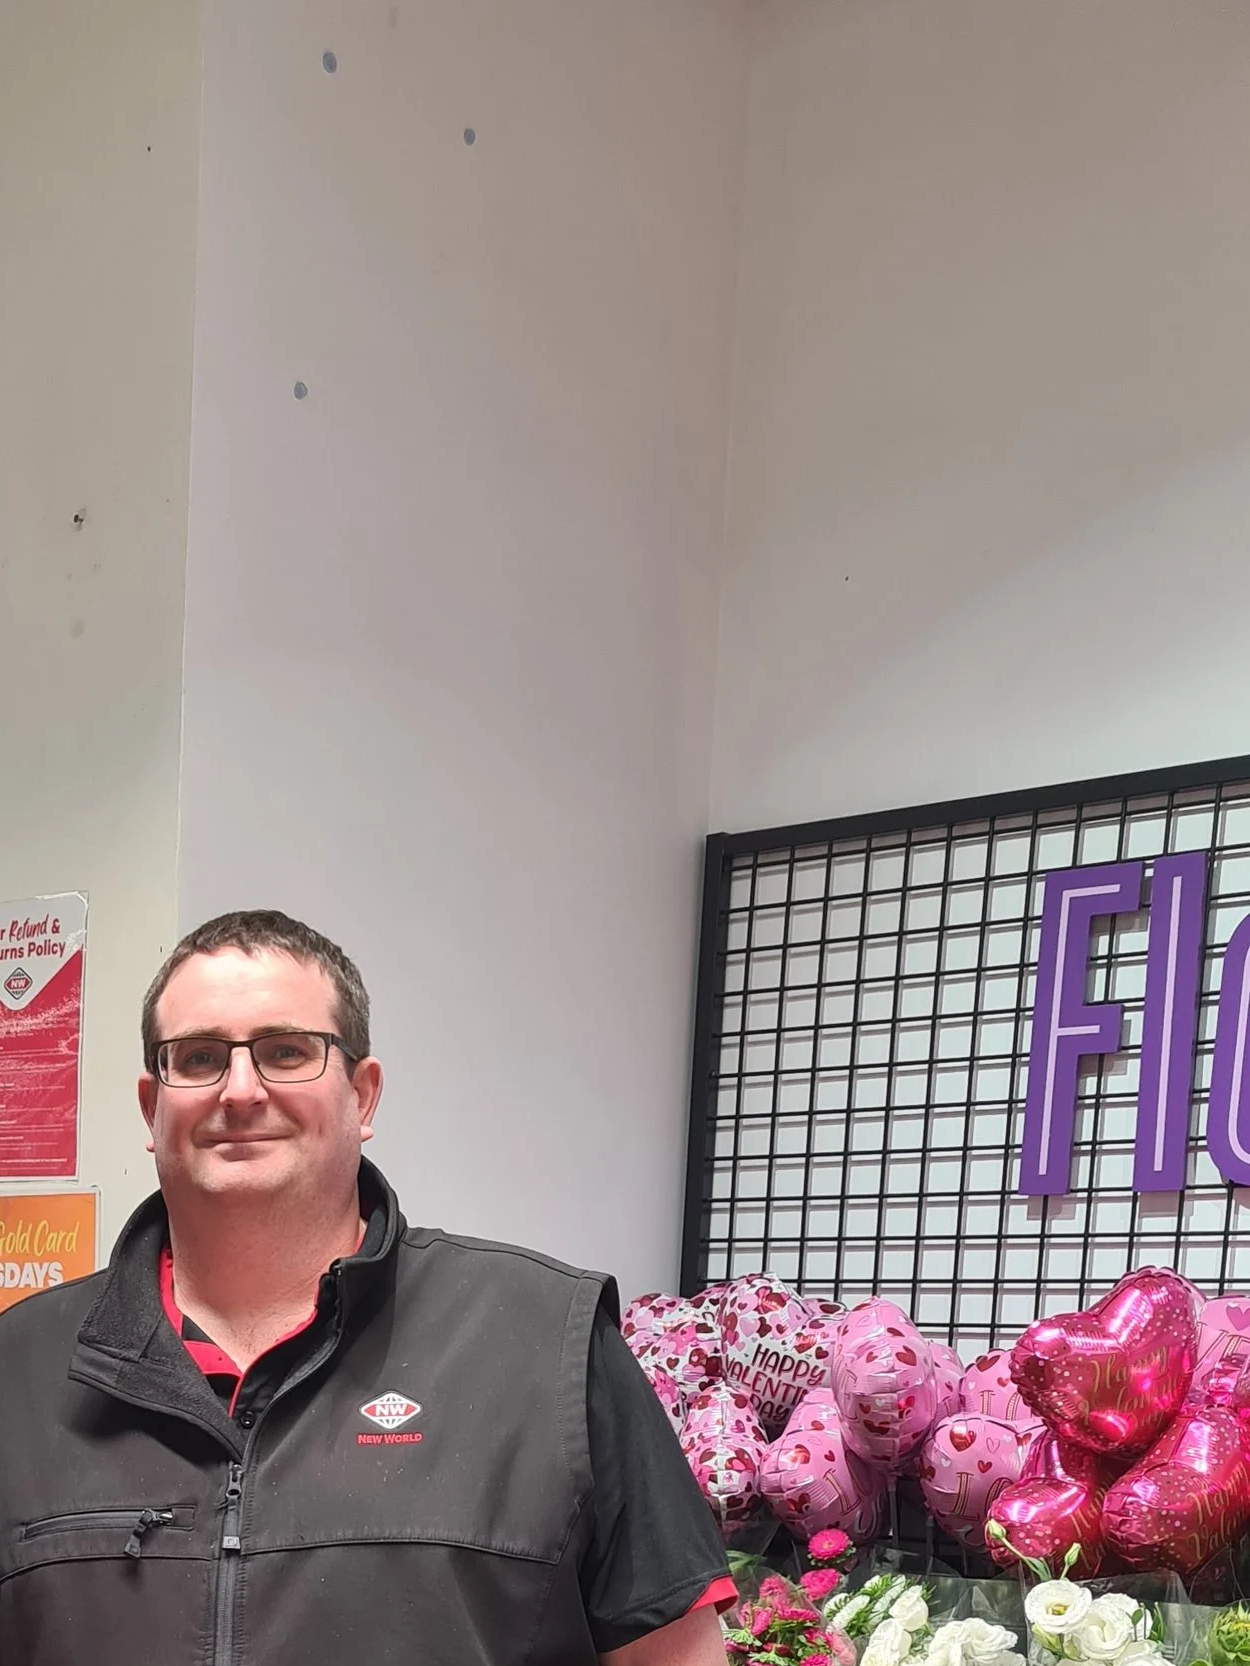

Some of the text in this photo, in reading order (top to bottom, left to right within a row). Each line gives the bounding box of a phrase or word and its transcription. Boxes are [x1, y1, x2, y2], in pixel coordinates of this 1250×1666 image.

[9, 913, 49, 944] Refund
[51, 917, 61, 934] &
[27, 939, 67, 958] Policy
[10, 979, 27, 989] NW
[33, 1220, 80, 1257] Card
[752, 1343, 827, 1387] HAPPY
[375, 1404, 407, 1416] NW
[358, 1433, 422, 1444] NEW WORLD
